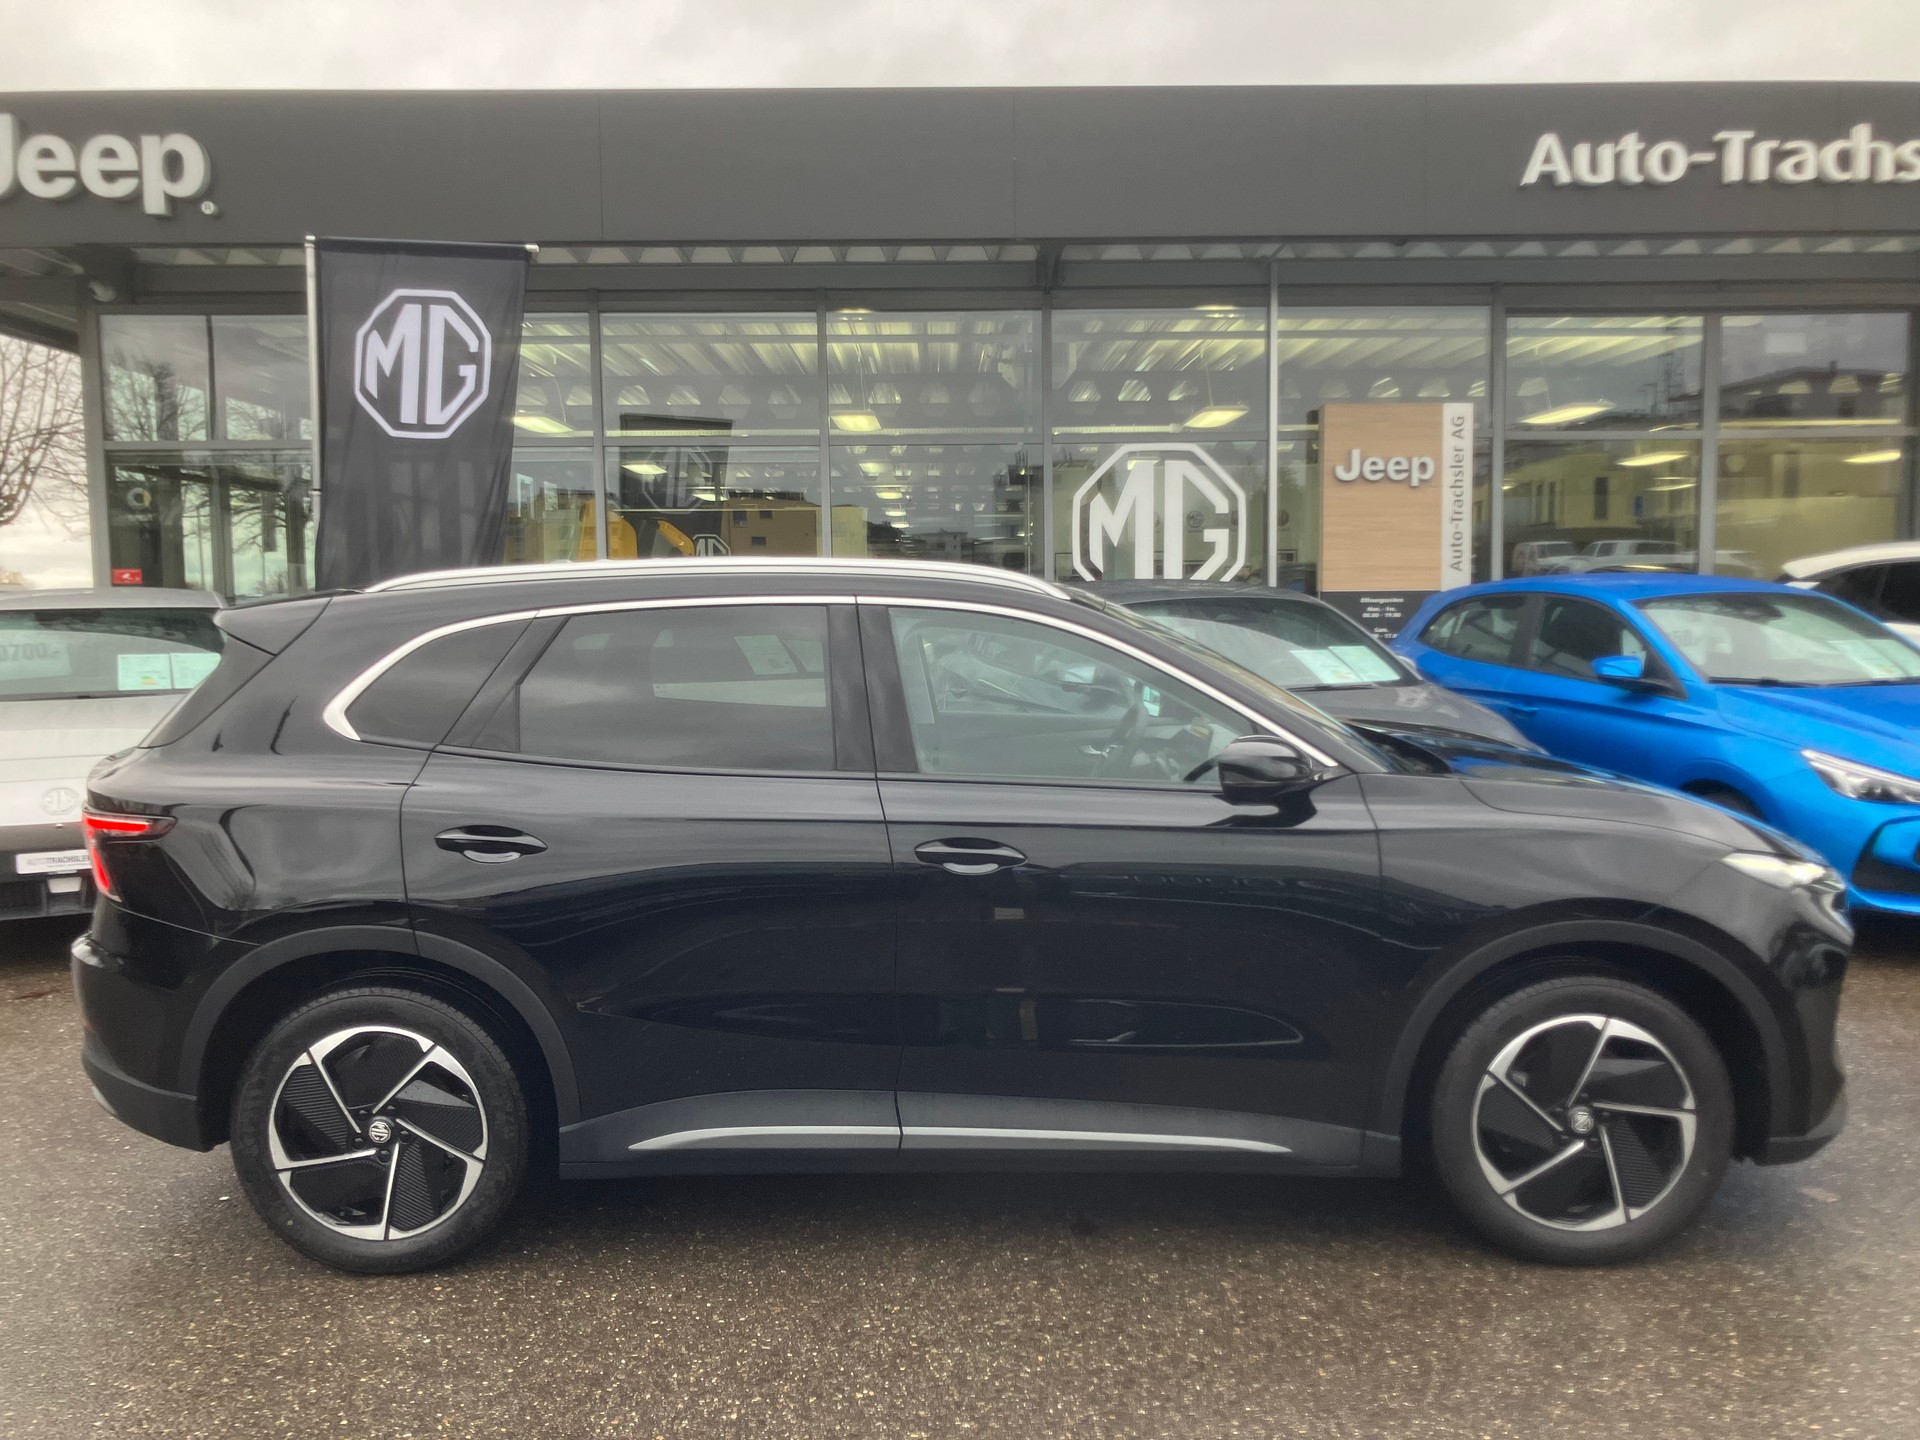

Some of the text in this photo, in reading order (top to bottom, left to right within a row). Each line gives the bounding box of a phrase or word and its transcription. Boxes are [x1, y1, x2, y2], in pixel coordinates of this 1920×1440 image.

[364, 303, 480, 425] MG
[1088, 459, 1230, 580] MG
[1334, 448, 1435, 487] Jeep
[1450, 415, 1465, 572] Auto-Trachsler AG
